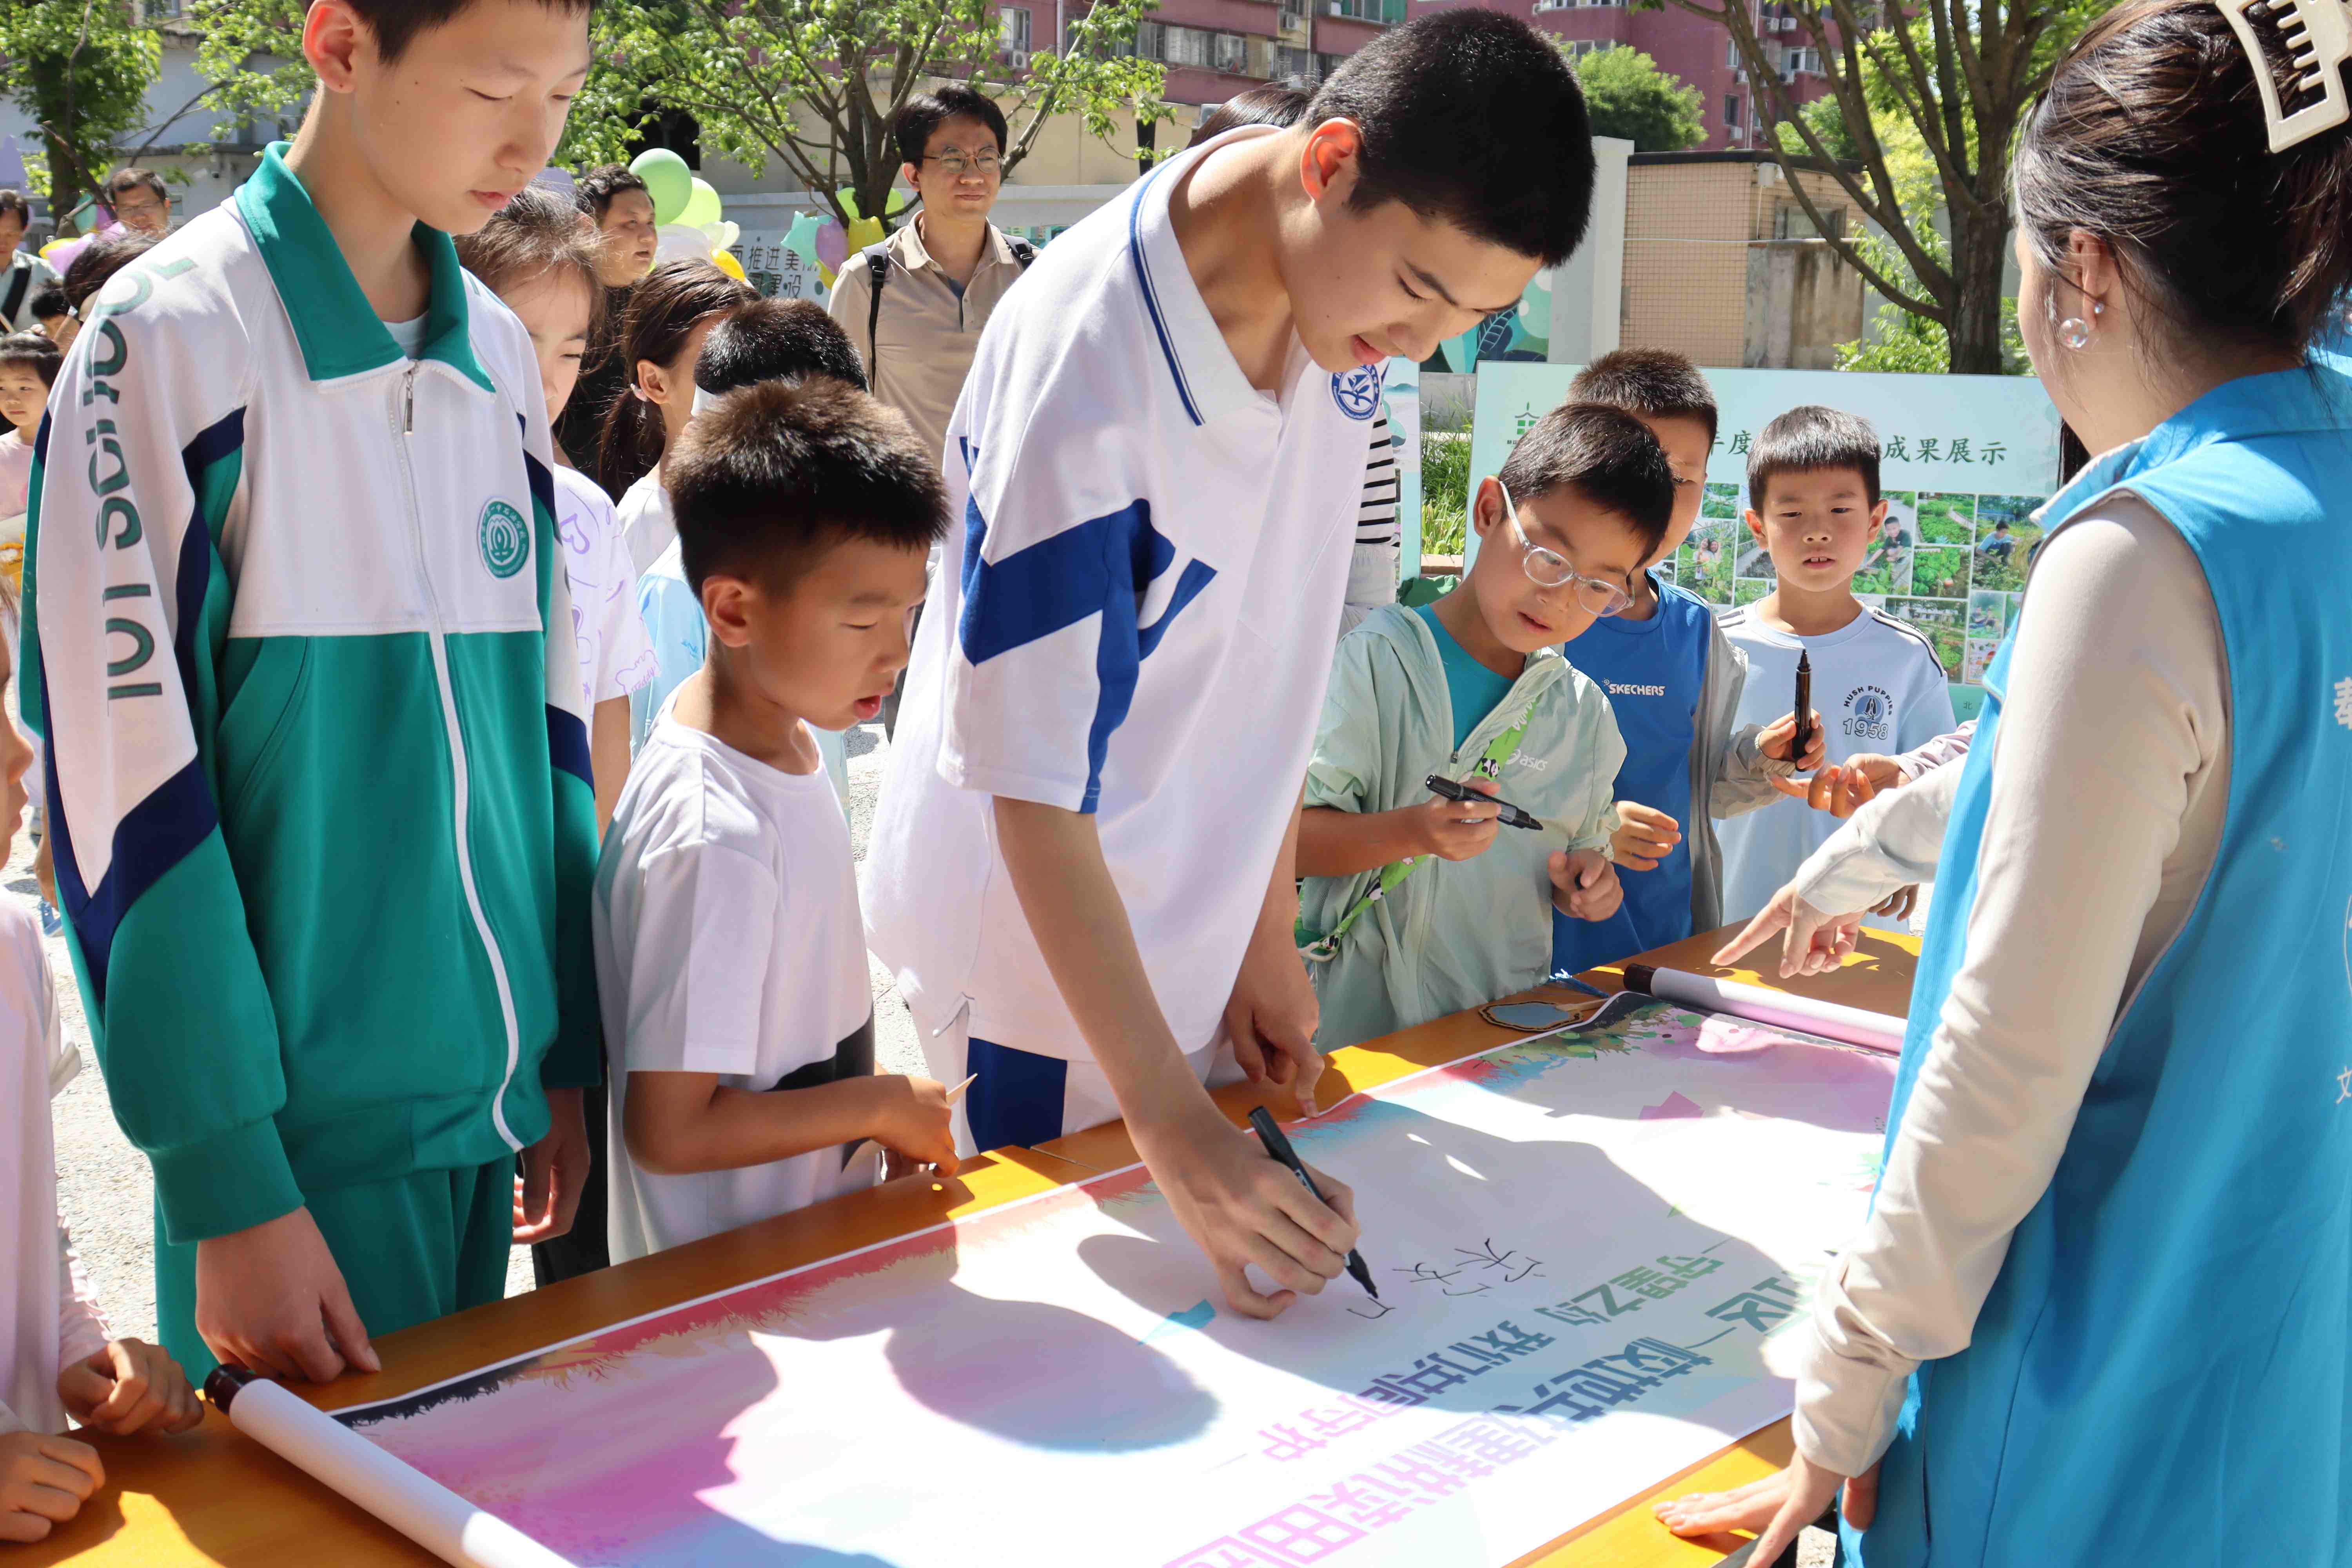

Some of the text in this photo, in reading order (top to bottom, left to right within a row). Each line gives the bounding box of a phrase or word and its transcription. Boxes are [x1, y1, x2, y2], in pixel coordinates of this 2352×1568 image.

[1882, 435, 2007, 466] 成果展示
[1608, 684, 1665, 696] SKECHERS
[1844, 685, 1893, 715] HUSH PUPPIES
[1843, 718, 1889, 740] 1958
[1258, 1319, 1556, 1461] 我们共同守护
